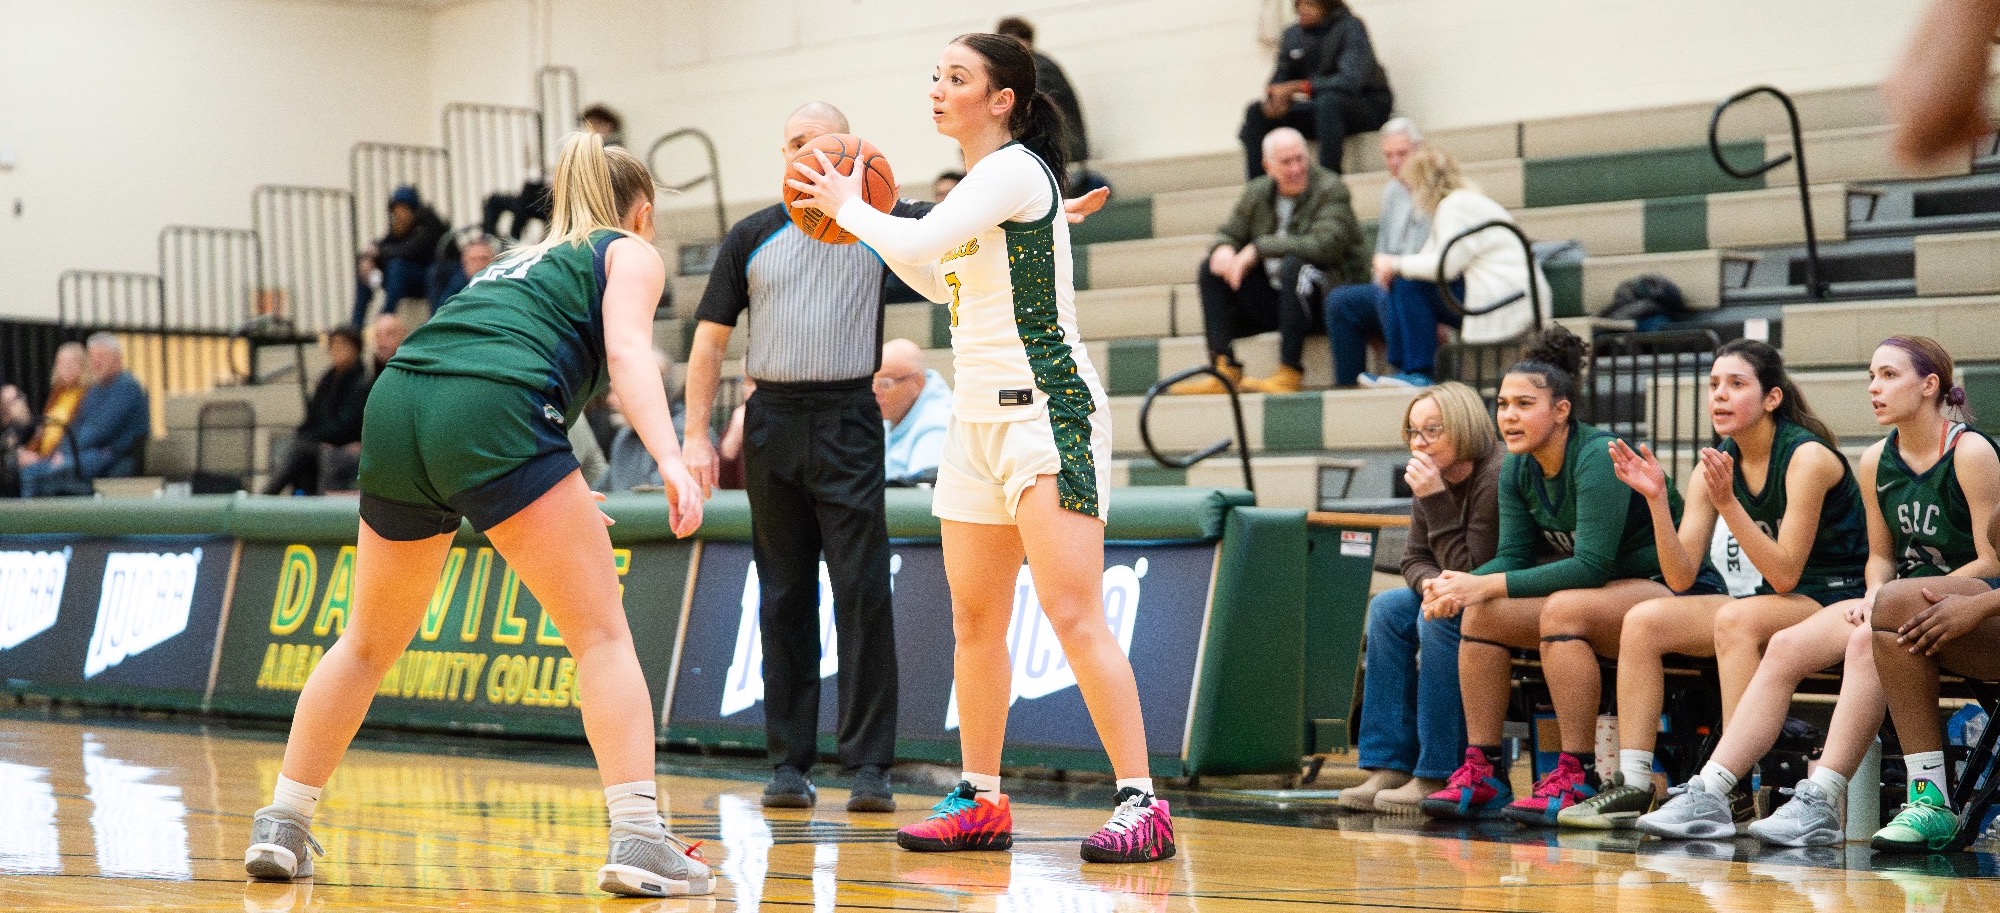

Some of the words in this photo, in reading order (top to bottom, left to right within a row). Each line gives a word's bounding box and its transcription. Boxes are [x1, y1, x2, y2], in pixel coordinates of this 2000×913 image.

[944, 271, 962, 328] 7
[269, 544, 632, 647] DAVIL
[486, 655, 582, 708] COLLE
